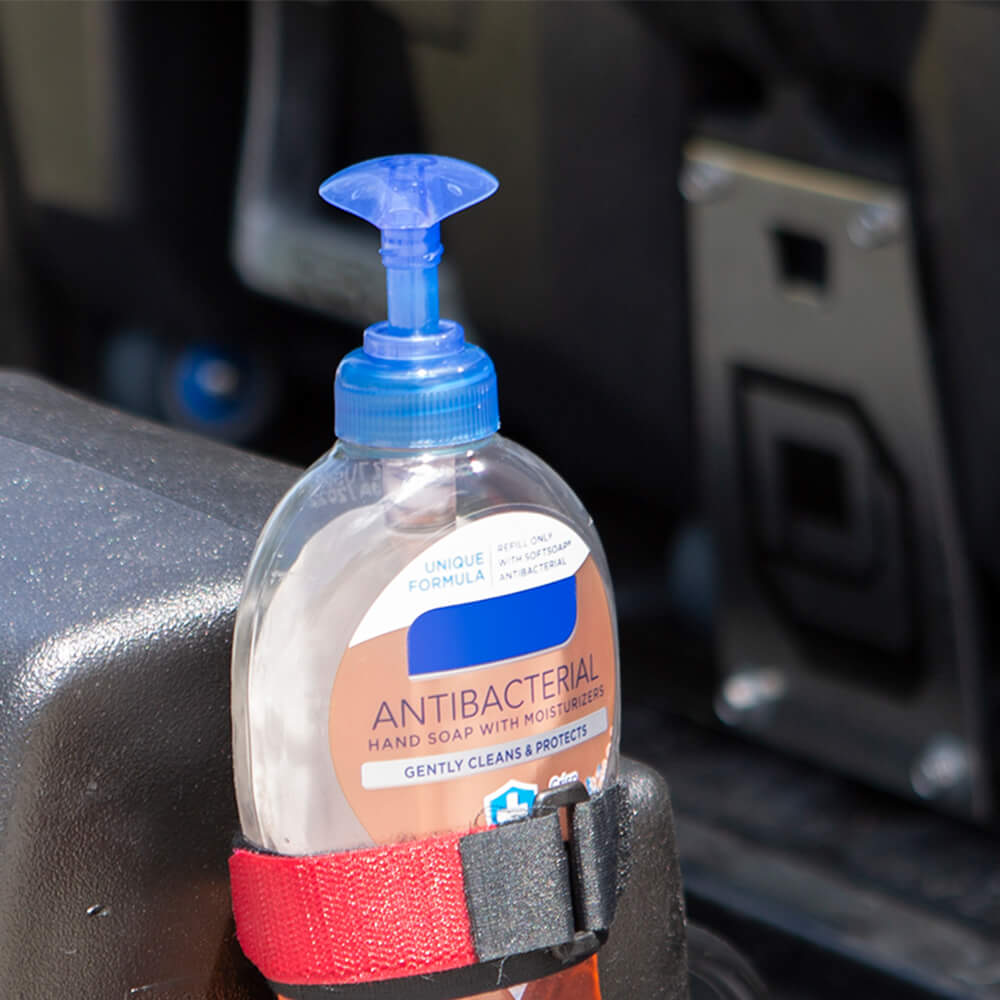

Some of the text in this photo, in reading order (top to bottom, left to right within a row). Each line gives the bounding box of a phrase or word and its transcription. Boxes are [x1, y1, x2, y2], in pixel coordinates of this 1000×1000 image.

[530, 532, 553, 545] ONLY
[425, 552, 484, 574] UNIQUE
[499, 557, 567, 580] ANTIBACTERIAL
[409, 569, 485, 592] FORMULA
[372, 653, 599, 731] ANTIBACTERIAL
[368, 685, 604, 752] HAND SOAP WITH MOISTURIZERS
[404, 724, 588, 779] GENTLY CLEANS & PROTECTS
